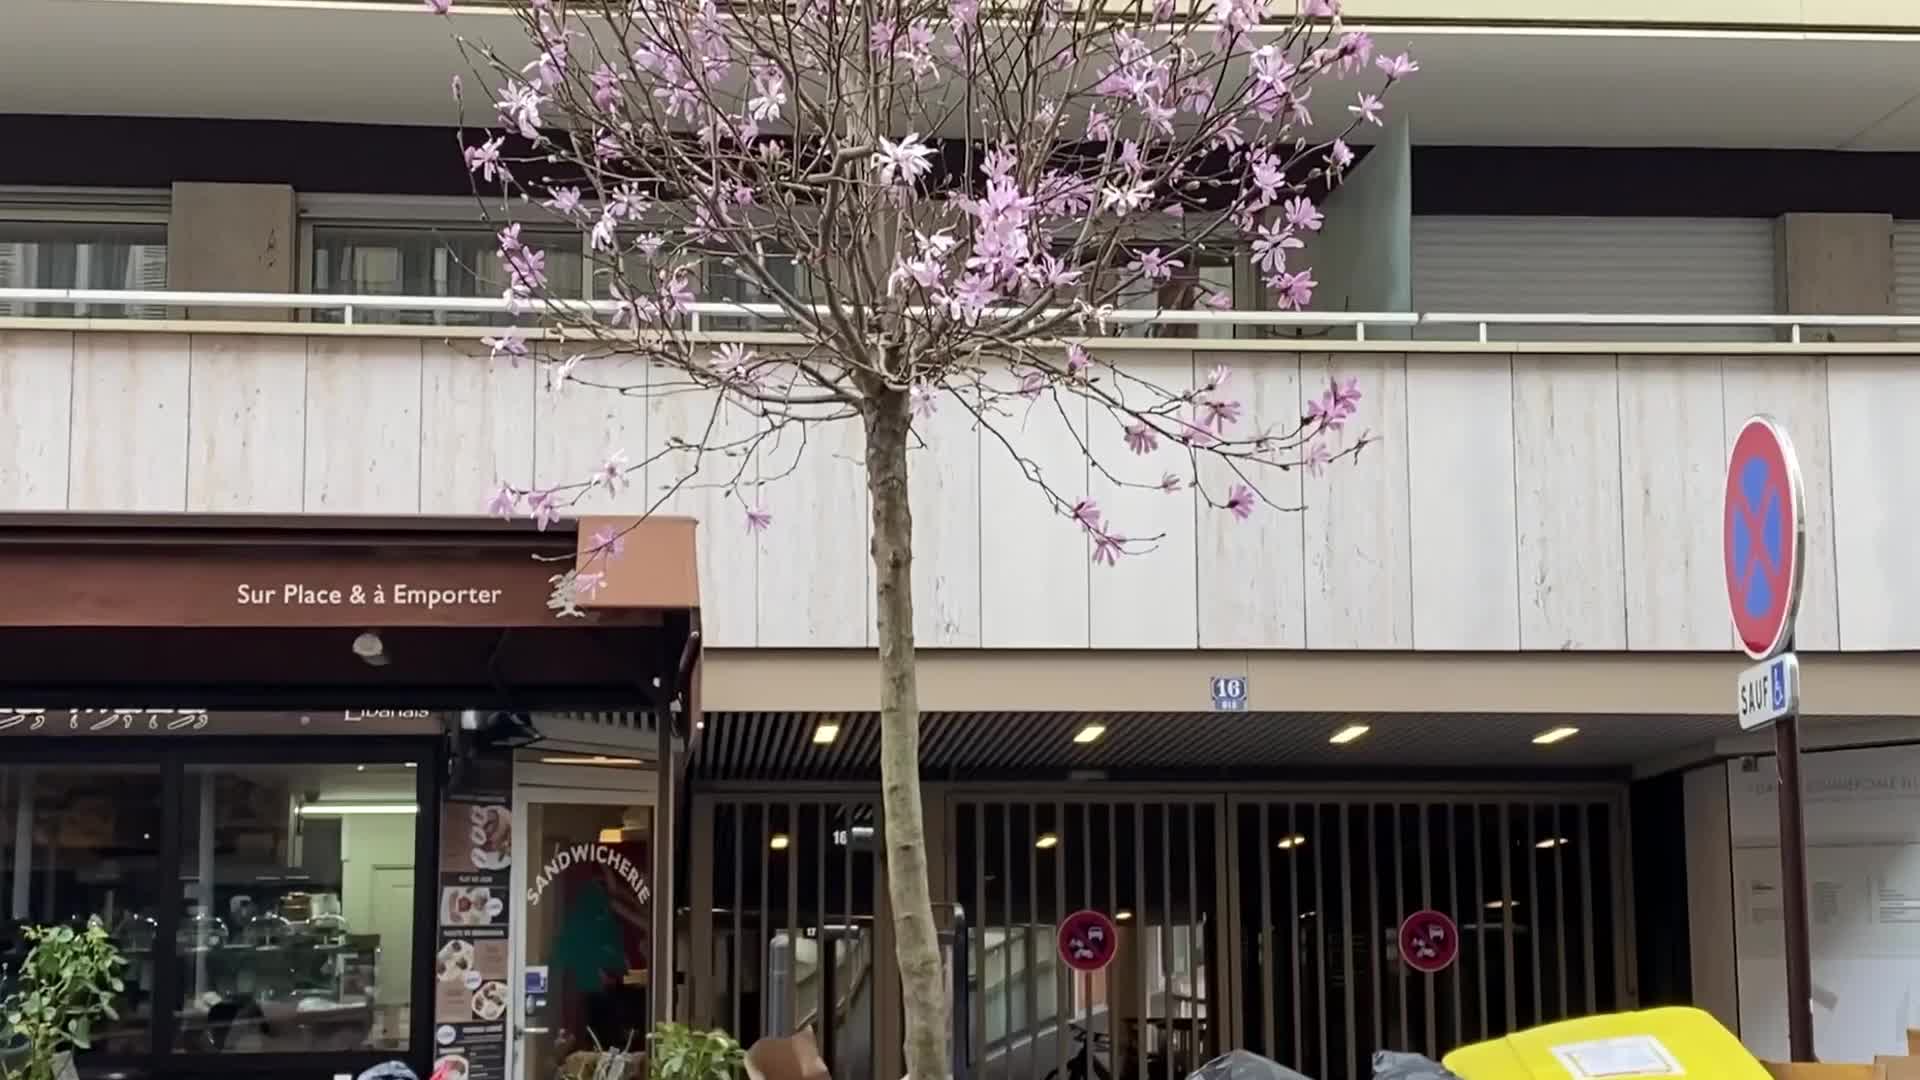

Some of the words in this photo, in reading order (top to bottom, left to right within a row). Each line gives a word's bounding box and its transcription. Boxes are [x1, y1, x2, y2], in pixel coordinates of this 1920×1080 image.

[237, 583, 276, 605] Sur
[284, 583, 342, 605] Place
[350, 584, 366, 605] &
[374, 583, 385, 605] à
[394, 583, 502, 609] Emporter
[1216, 679, 1240, 698] 16
[1741, 676, 1768, 716] SAUF
[527, 843, 651, 906] SANDWICHERIE
